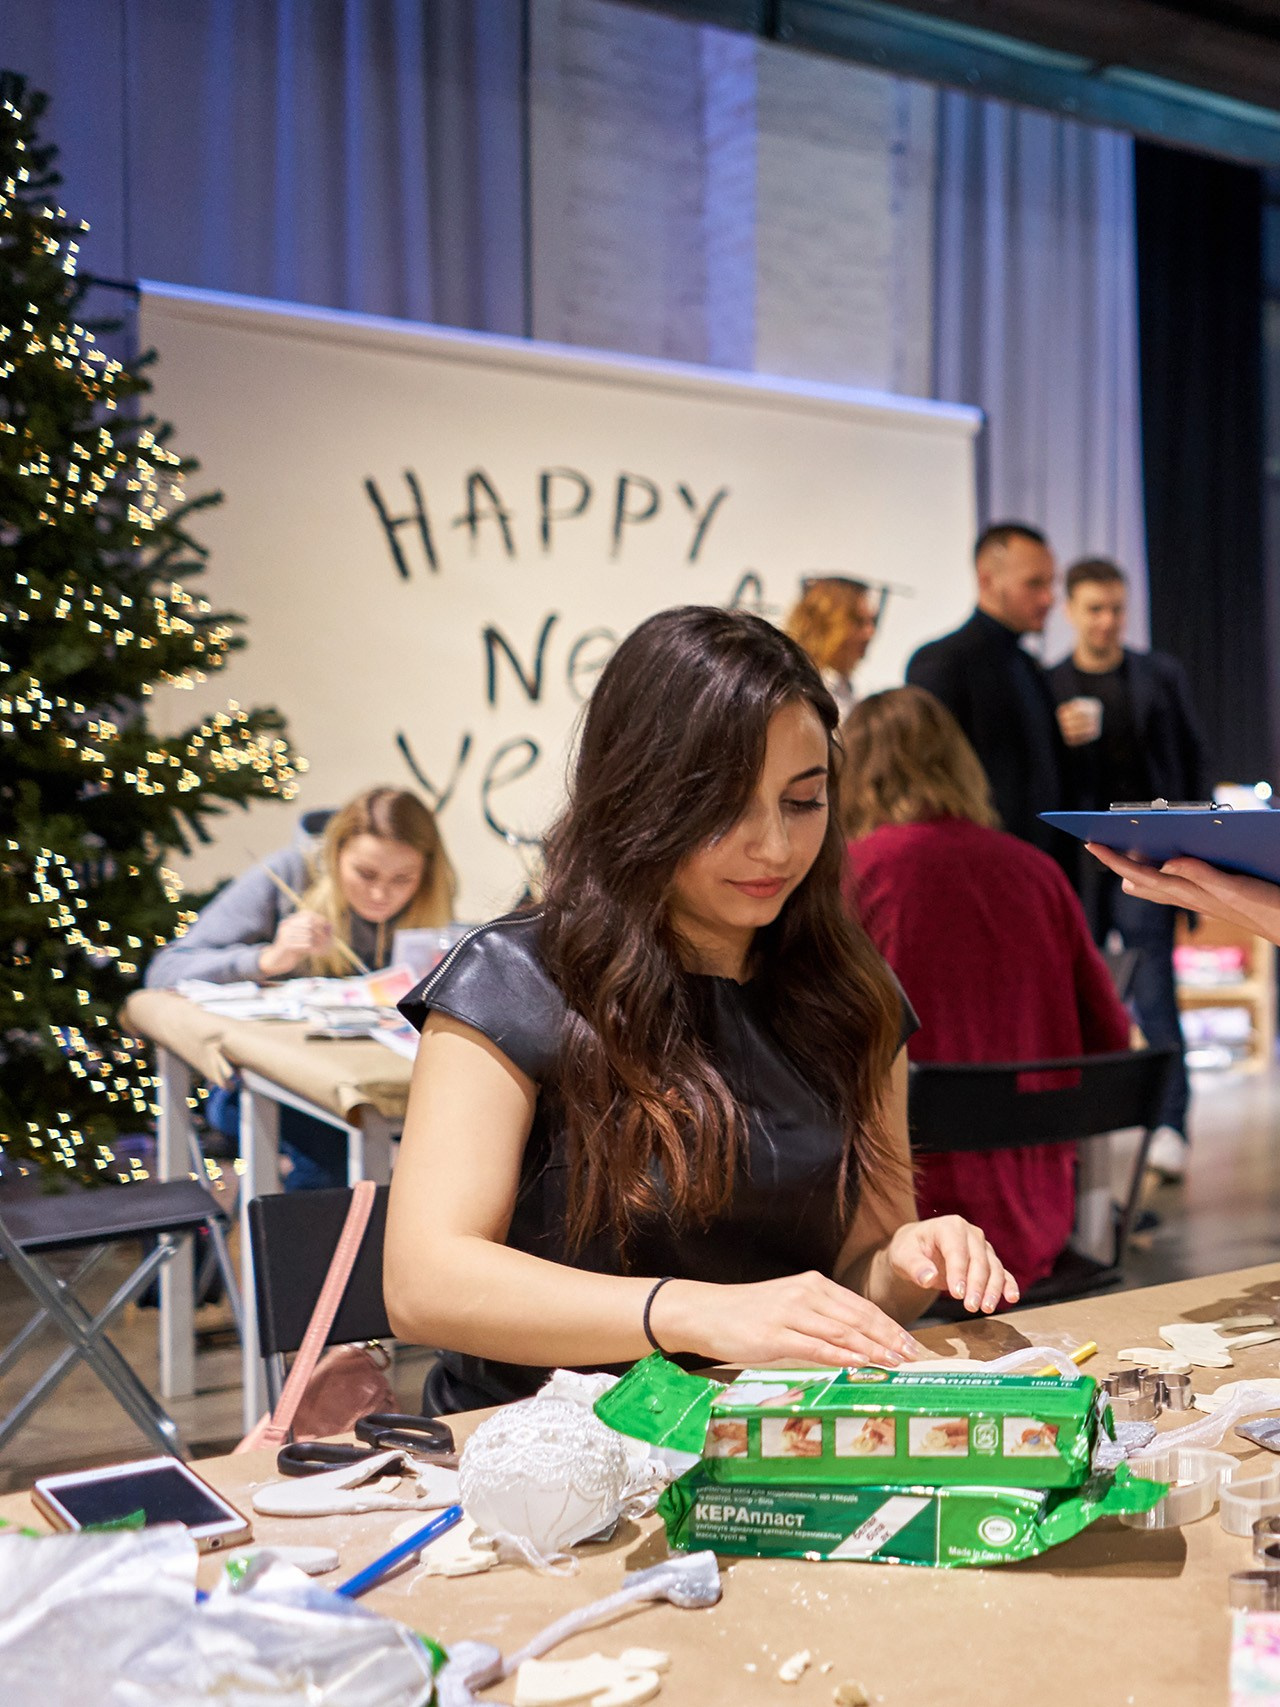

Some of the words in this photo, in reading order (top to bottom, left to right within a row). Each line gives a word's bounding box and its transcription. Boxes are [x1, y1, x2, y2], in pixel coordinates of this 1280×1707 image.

[364, 467, 730, 581] HAPPY
[483, 611, 615, 708] Ne
[396, 730, 543, 845] Ye
[891, 1376, 1003, 1386] КЕРАпласт
[695, 1503, 805, 1527] КЕРАпласт
[948, 1546, 971, 1557] Made
[973, 1547, 980, 1558] in
